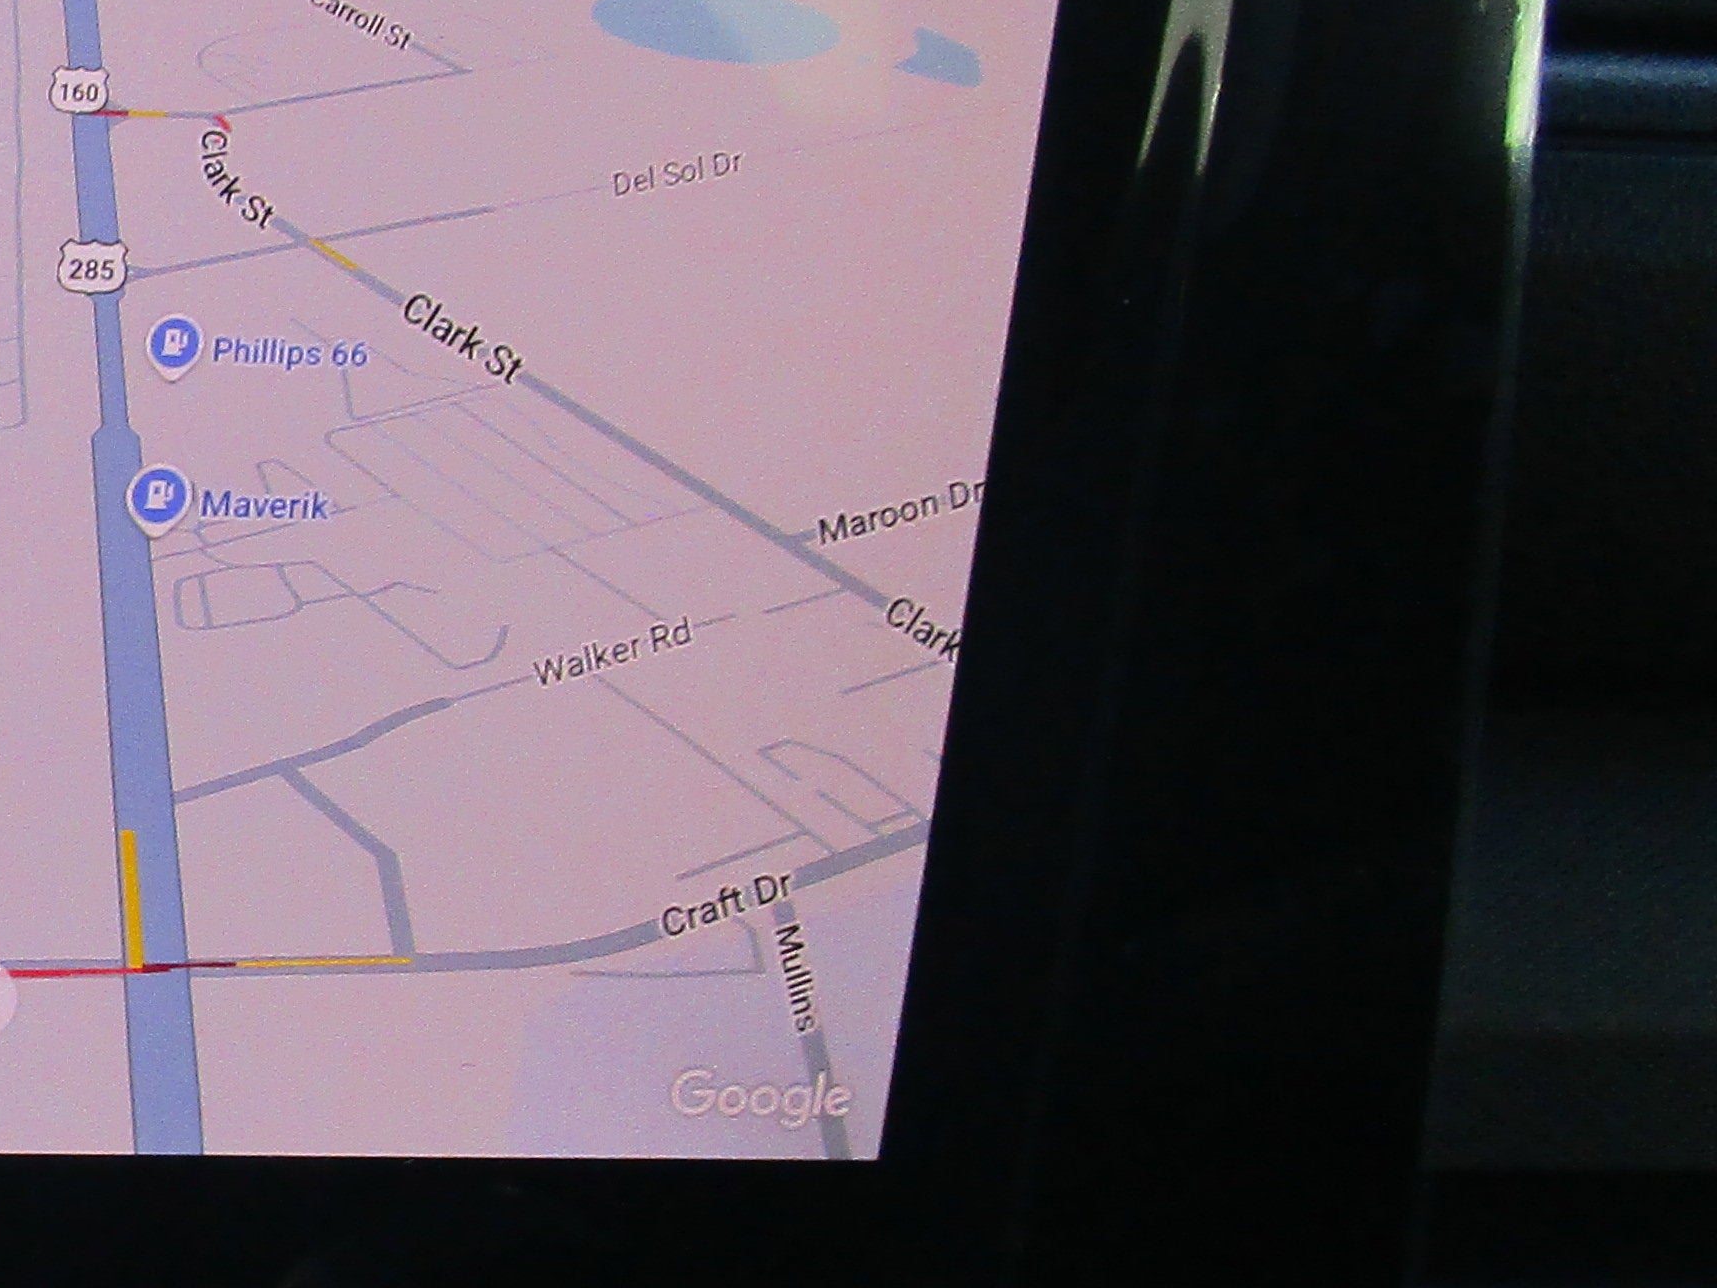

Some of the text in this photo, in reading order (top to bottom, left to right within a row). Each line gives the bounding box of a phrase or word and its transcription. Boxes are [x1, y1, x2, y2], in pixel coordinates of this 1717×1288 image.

[383, 25, 410, 50] St
[61, 83, 99, 102] 160
[201, 130, 273, 229] Clark St
[614, 151, 743, 196] Del Sol Dr
[69, 260, 114, 280] 285
[213, 337, 368, 370] Phillips 66
[404, 294, 524, 384] Clark St
[200, 490, 329, 521] Maverik
[818, 479, 987, 545] Maroon Dr
[533, 617, 692, 687] Walker Rd
[884, 598, 961, 661] Clark
[662, 872, 791, 937] Craft Dr
[777, 924, 817, 1033] Mullins
[671, 1069, 853, 1127] Google
